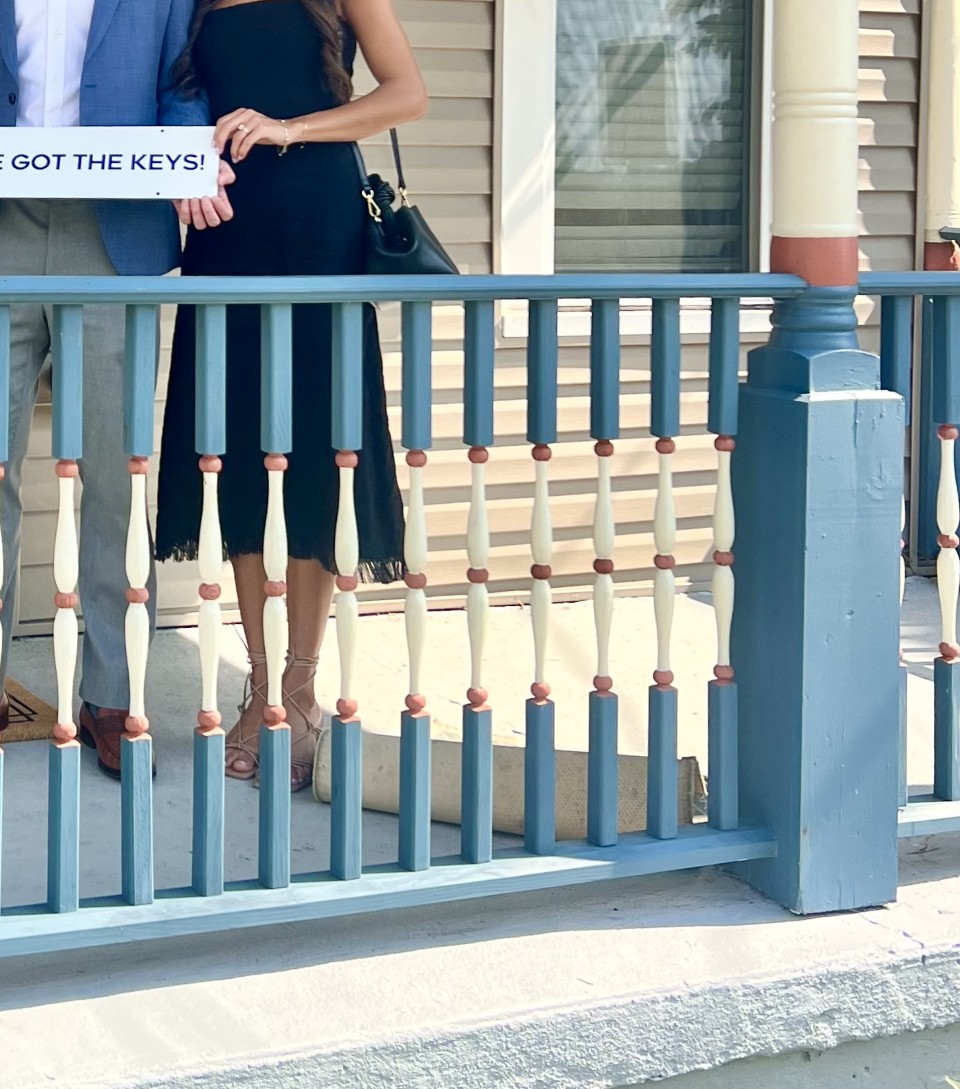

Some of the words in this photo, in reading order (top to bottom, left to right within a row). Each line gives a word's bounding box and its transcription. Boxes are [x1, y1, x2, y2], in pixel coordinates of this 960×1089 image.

[11, 153, 67, 171] GOT
[73, 153, 123, 170] THE
[130, 153, 205, 171] KEYS!
